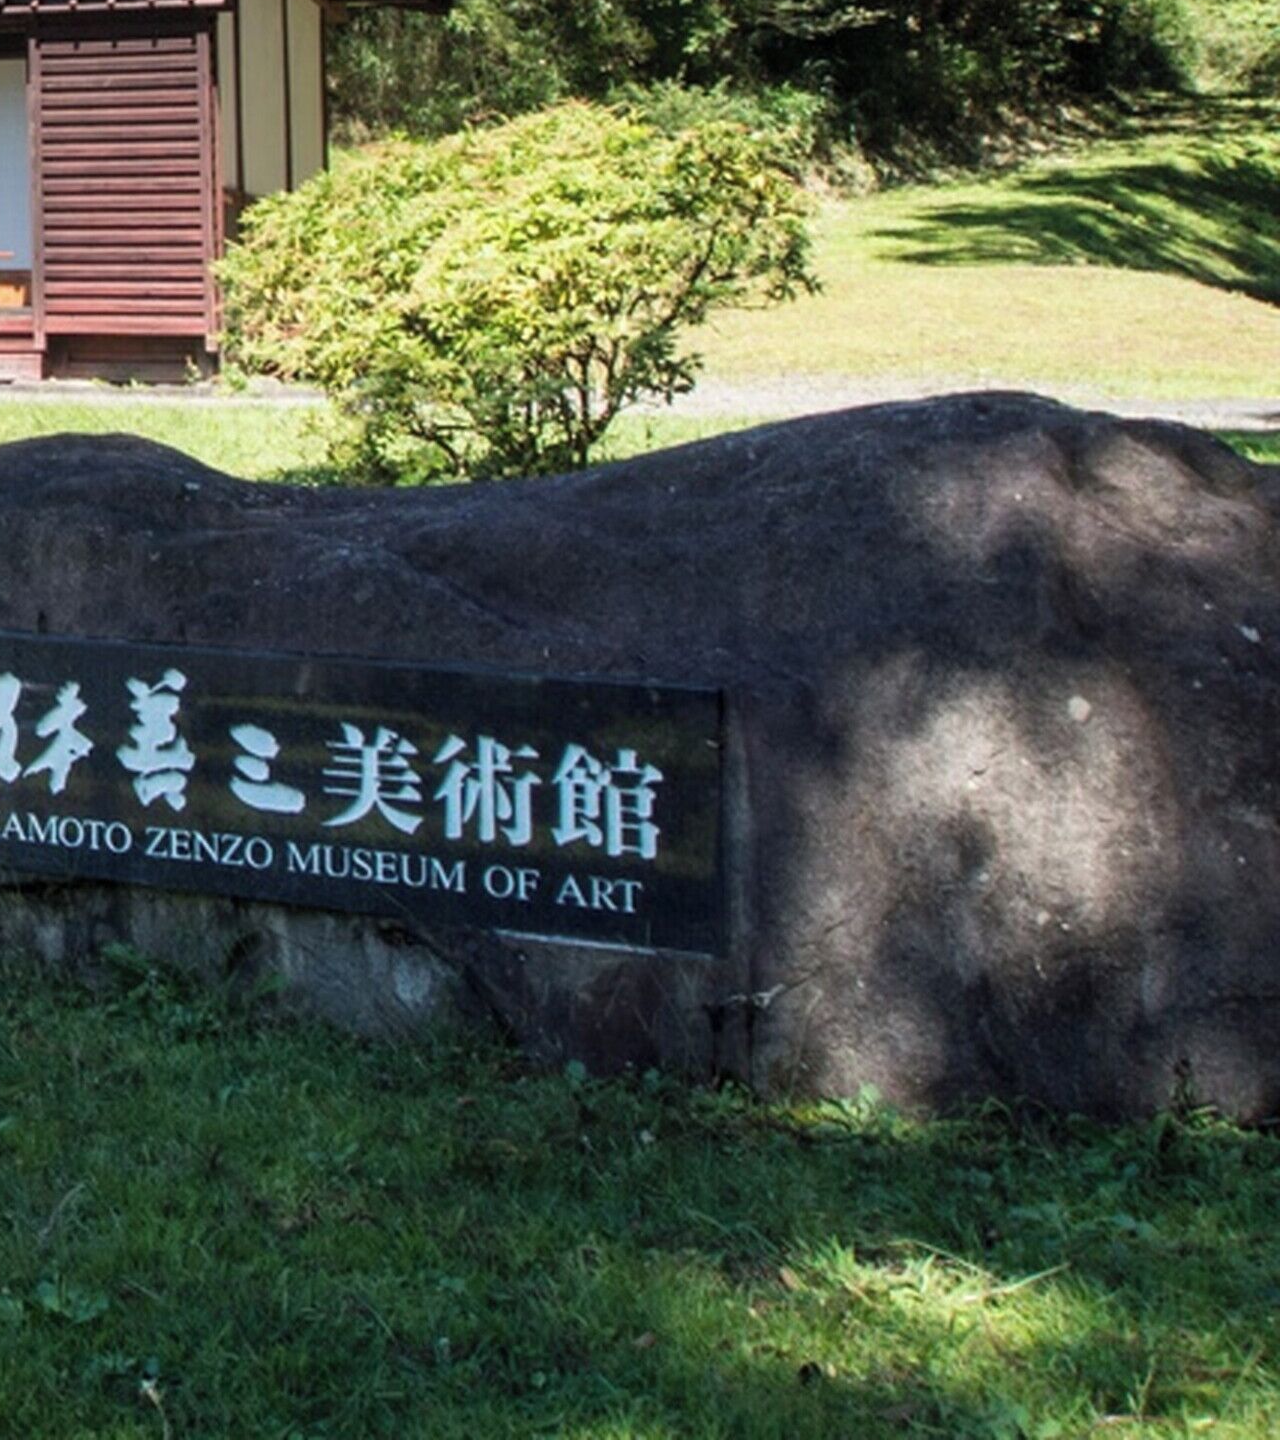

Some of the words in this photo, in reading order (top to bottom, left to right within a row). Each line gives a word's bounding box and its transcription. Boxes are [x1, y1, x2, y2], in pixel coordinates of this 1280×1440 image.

[145, 826, 274, 869] ZENZO
[287, 841, 466, 894] MUSEUM
[483, 865, 540, 903] OF
[556, 874, 643, 914] ART
